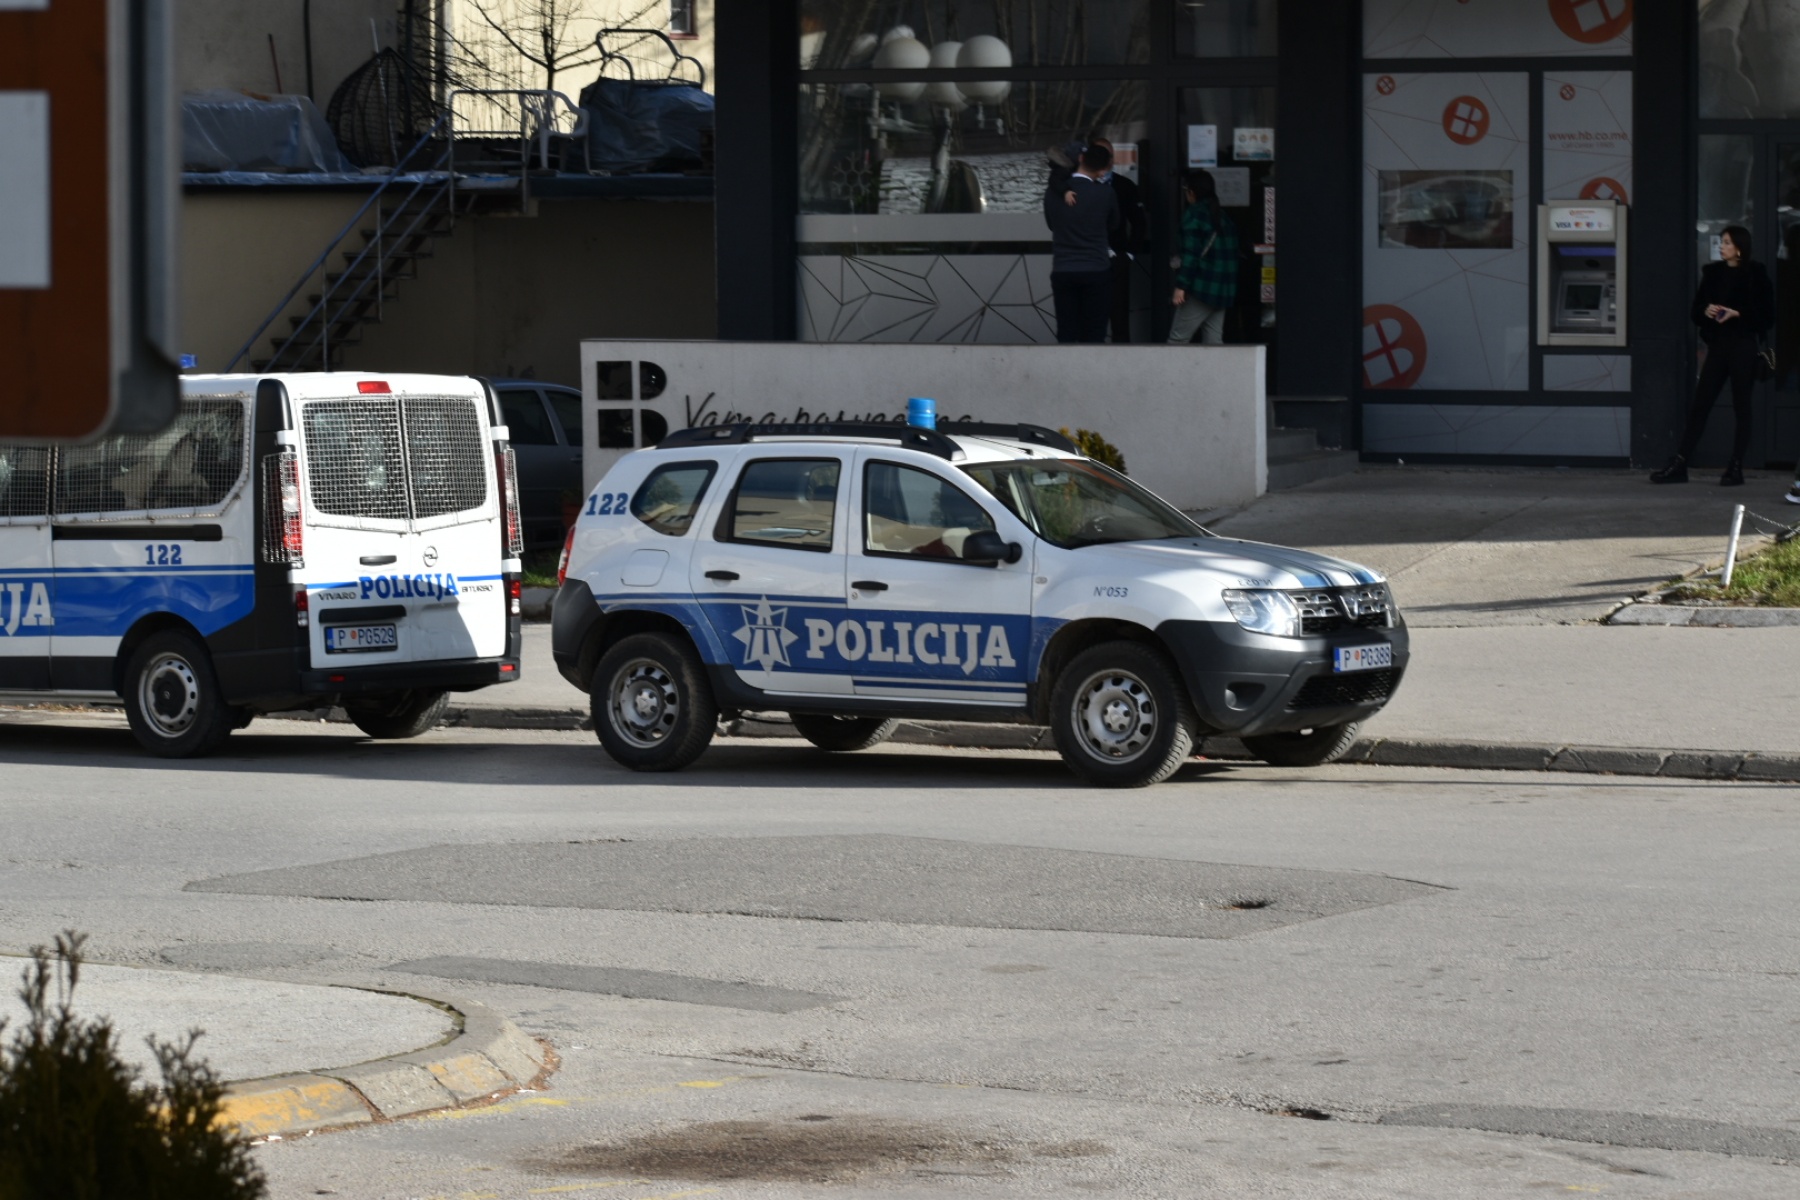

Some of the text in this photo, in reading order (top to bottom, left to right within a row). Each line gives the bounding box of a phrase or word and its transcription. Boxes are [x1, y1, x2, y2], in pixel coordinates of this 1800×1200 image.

[1548, 131, 1629, 141] www.hb.co.me
[1555, 221, 1572, 229] VISA
[752, 425, 832, 433] DUSTER
[585, 492, 629, 515] 122
[145, 544, 182, 565] 122
[359, 573, 459, 602] POLICIJA
[461, 585, 493, 593] BITURBO
[1093, 586, 1129, 598] N°053
[318, 592, 357, 601] VIVARO
[0, 582, 55, 637] JA
[358, 627, 395, 646] PG529
[804, 617, 1017, 676] POLICIJA
